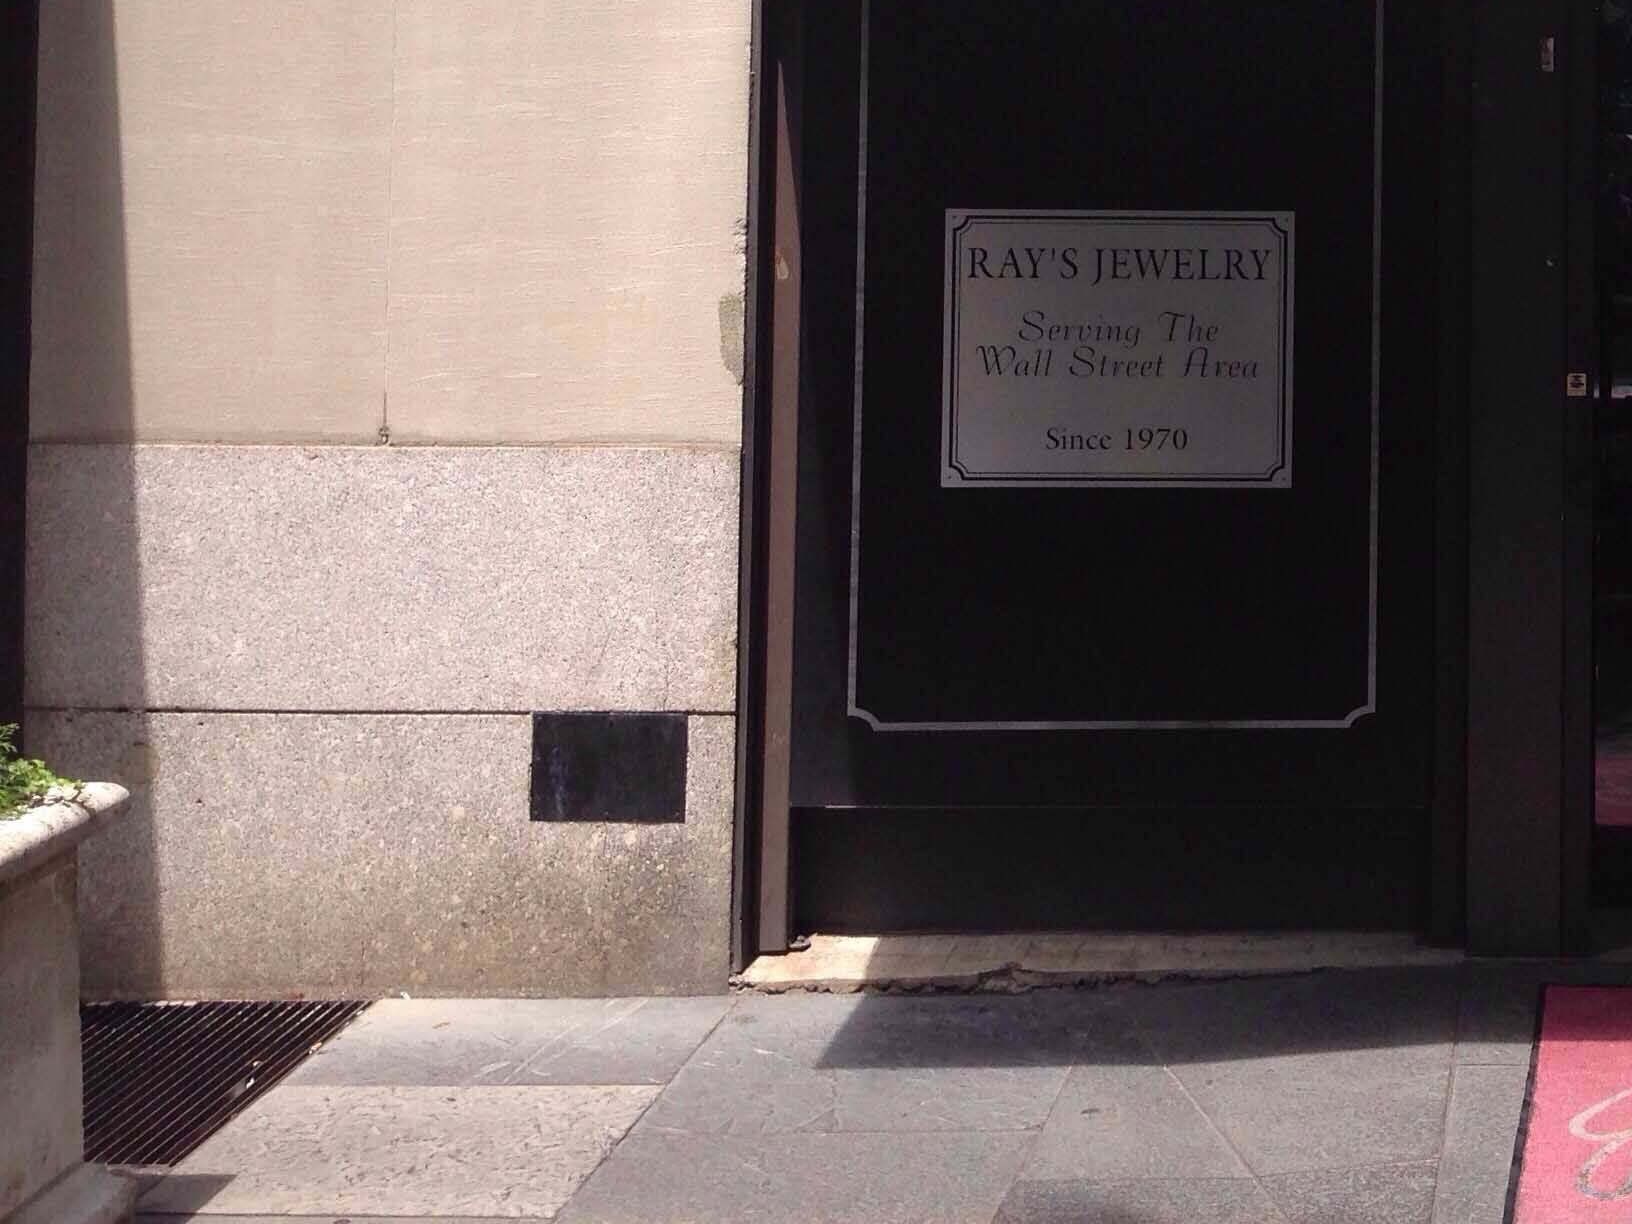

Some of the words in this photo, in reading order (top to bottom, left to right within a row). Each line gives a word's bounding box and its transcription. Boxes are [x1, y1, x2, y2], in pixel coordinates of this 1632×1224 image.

[967, 247, 1079, 279] RAY'S
[1092, 248, 1271, 286] JEWELRY
[1018, 310, 1141, 348] Serving
[1159, 310, 1219, 343] The
[976, 345, 1052, 377] Wall
[1069, 345, 1166, 377] Street
[1183, 346, 1259, 378] Area
[1045, 427, 1112, 450] Since
[1125, 427, 1188, 451] 1970
